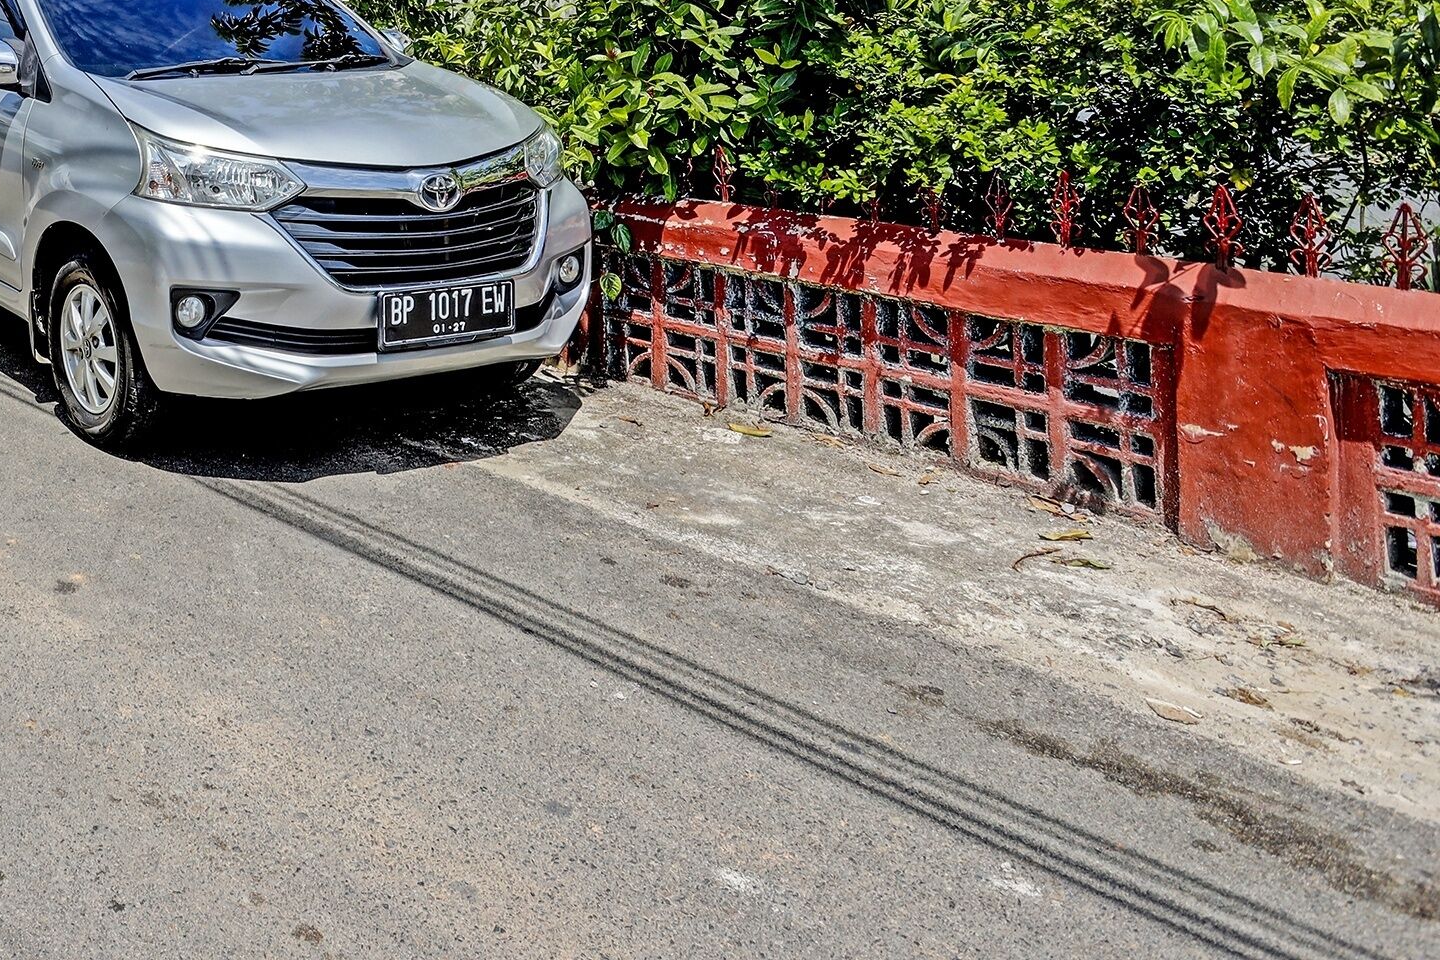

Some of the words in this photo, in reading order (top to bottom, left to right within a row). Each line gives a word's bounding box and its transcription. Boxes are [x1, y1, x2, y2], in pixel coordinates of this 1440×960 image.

[391, 296, 415, 325] BP
[428, 288, 473, 321] 1017
[481, 285, 506, 314] EW
